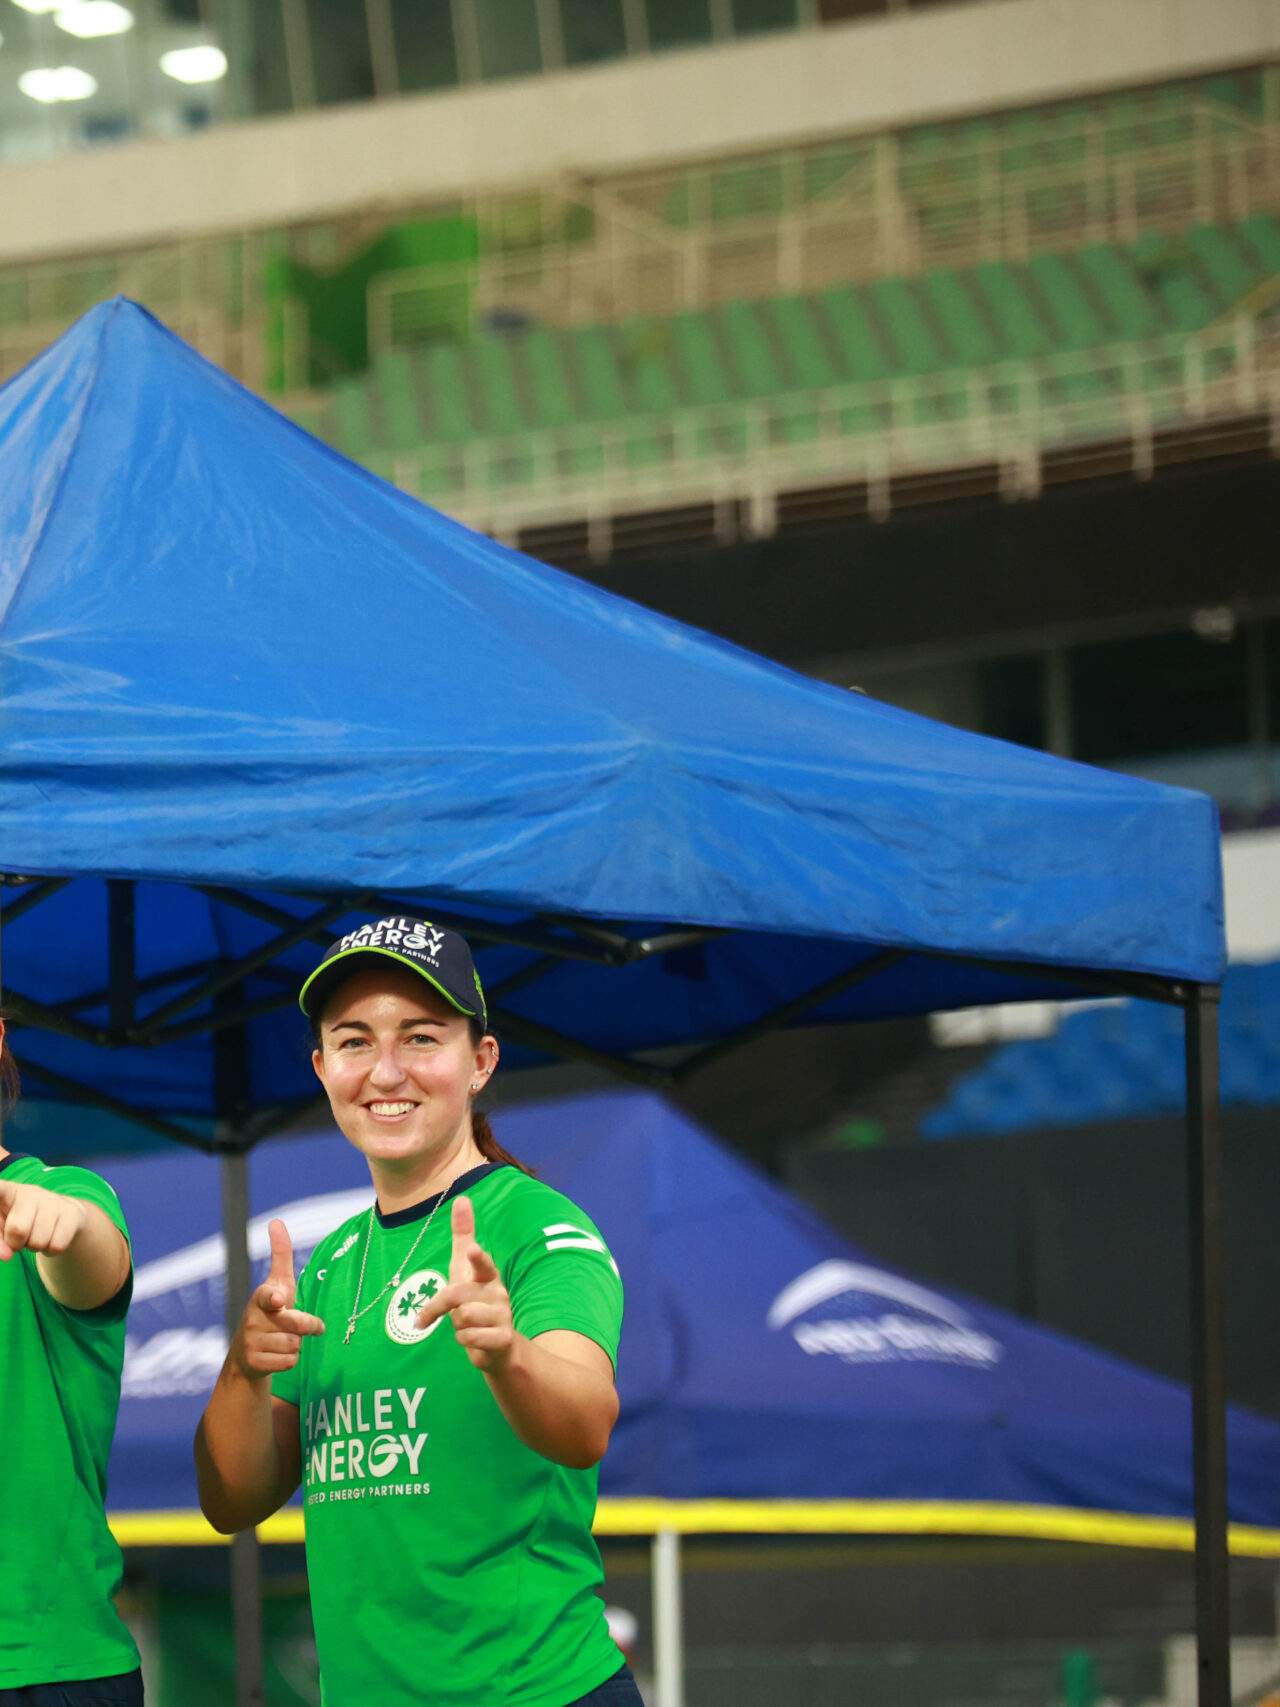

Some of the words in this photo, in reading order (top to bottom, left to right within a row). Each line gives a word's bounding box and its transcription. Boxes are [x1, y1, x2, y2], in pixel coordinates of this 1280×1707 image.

[340, 918, 445, 947] HANLEY
[329, 1487, 366, 1502] ENERGY
[369, 1482, 431, 1497] PARTNERS
